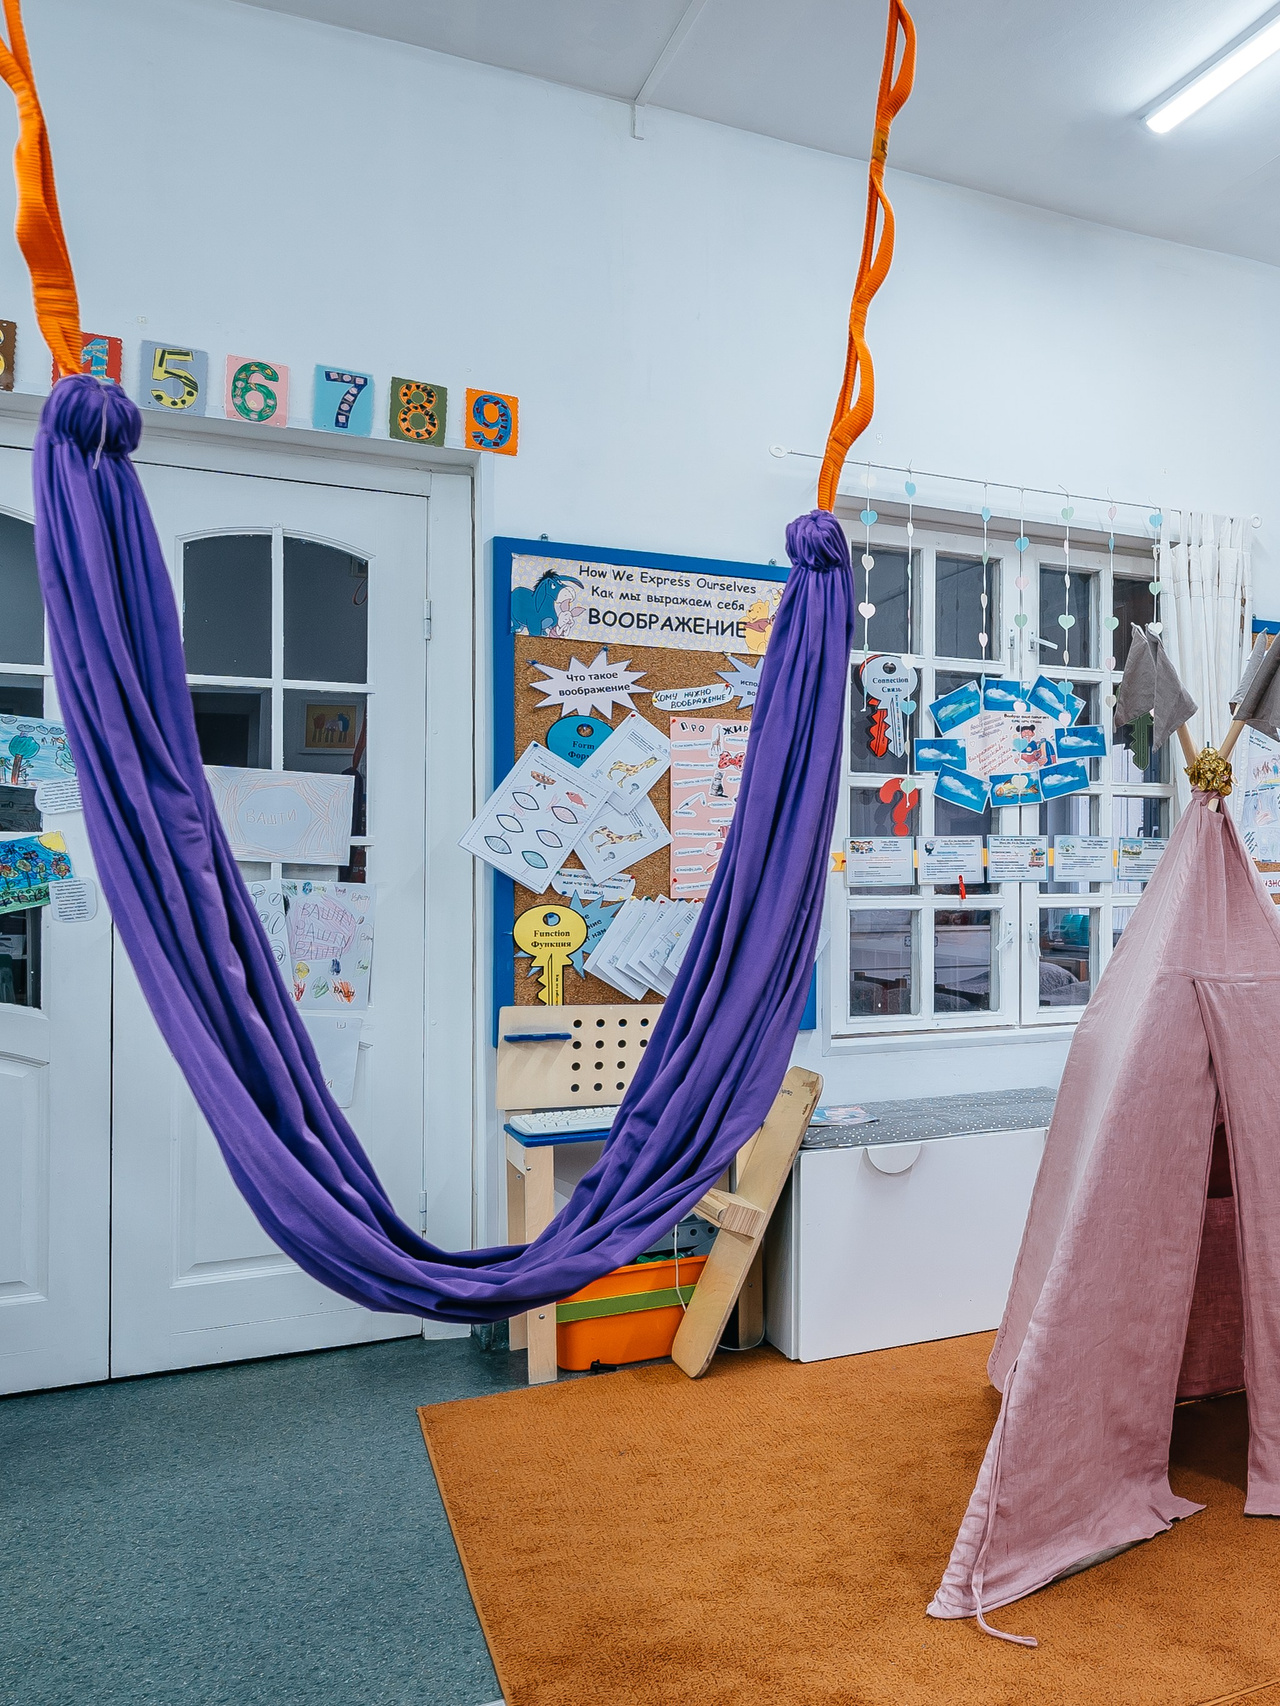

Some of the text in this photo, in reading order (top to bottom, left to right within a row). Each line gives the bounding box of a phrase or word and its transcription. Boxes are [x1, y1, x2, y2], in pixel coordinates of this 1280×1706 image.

[151, 347, 199, 409] 5
[231, 361, 279, 422] 6
[324, 370, 368, 429] 7
[398, 382, 439, 440] 8
[472, 393, 513, 450] 9
[579, 565, 756, 594] How We Express Ourselves
[591, 585, 745, 612] Как мы выражаем себя
[588, 608, 747, 639] ВООБРАЖЕНИЕ
[566, 671, 619, 683] Что такое
[558, 683, 631, 697] воображение
[680, 722, 706, 732] ПРО
[573, 741, 595, 750] Form
[246, 808, 297, 825] ВАШТИ
[533, 930, 570, 938] Function
[531, 941, 572, 950] Функция
